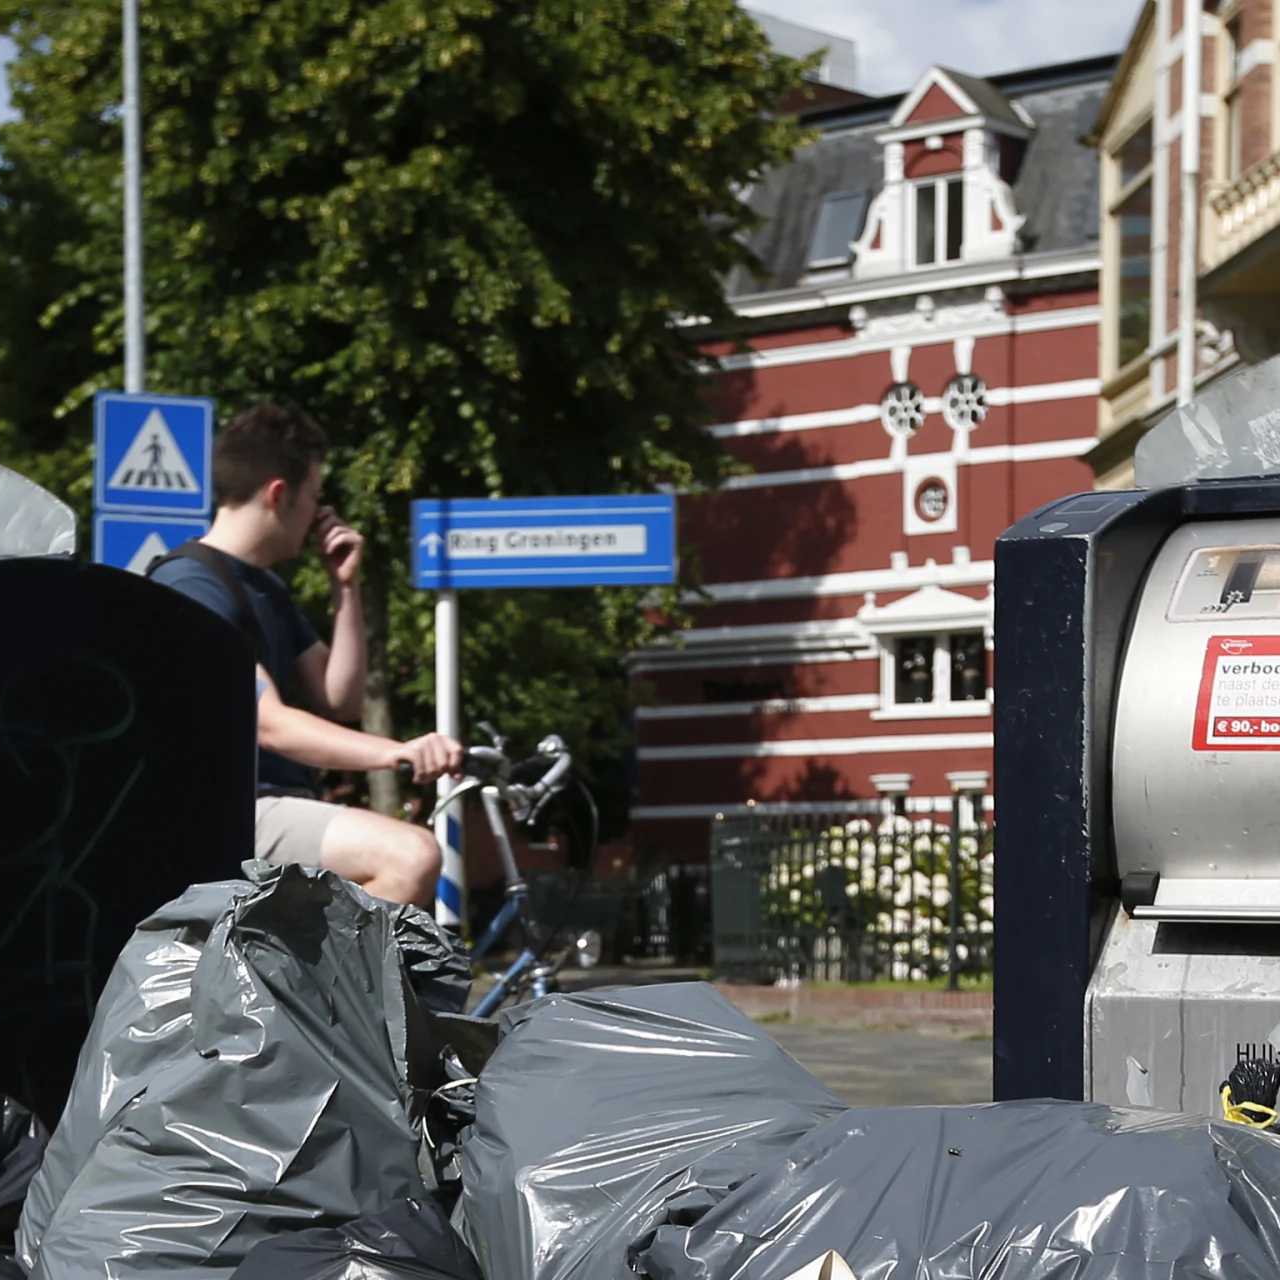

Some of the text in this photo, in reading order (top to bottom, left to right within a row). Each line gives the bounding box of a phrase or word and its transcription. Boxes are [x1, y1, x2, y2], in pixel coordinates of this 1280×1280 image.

[451, 529, 617, 552] Ring Groningen
[1218, 679, 1257, 691] naast
[1261, 679, 1280, 691] de
[1216, 695, 1231, 707] te
[1217, 721, 1227, 733] €
